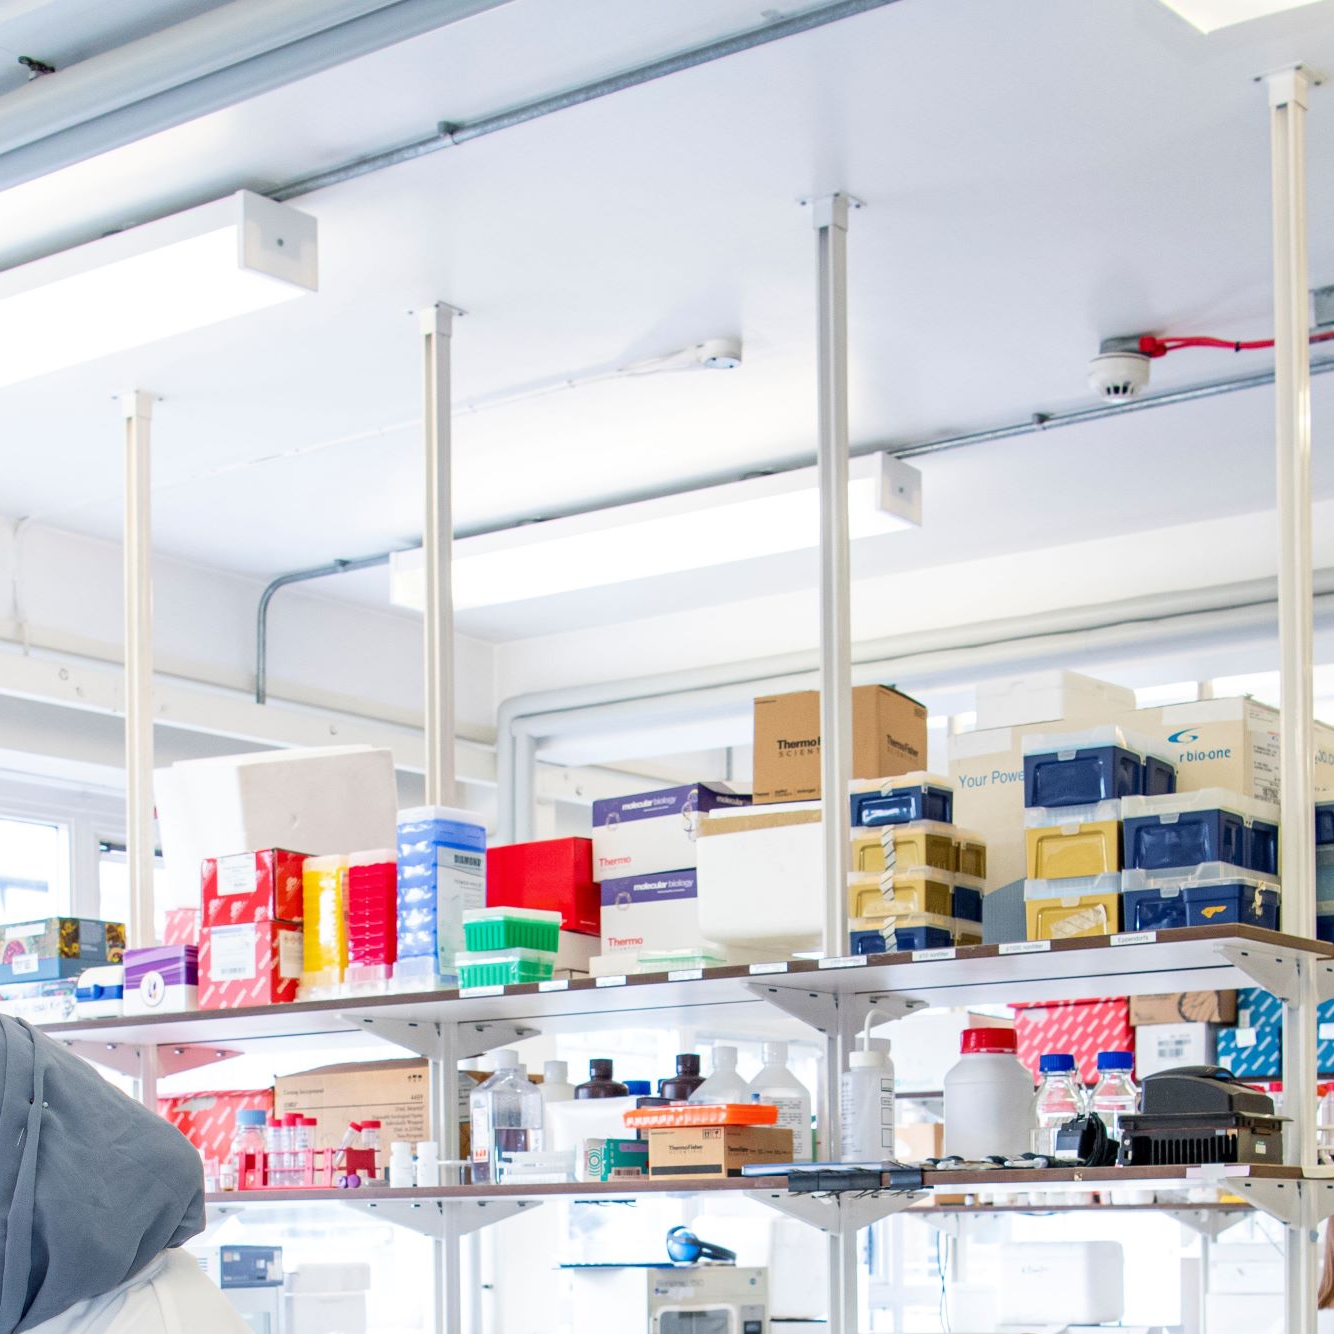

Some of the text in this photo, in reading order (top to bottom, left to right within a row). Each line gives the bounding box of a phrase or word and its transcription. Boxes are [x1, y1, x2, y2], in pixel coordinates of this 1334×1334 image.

[1187, 747, 1231, 762] bio-one
[958, 767, 1024, 789] Your Powe
[621, 796, 677, 811] molecular biology
[599, 856, 632, 868] Thermo
[633, 878, 694, 892] molecular biology
[608, 937, 643, 948] Thermo
[1118, 935, 1149, 944] Eppendorfs
